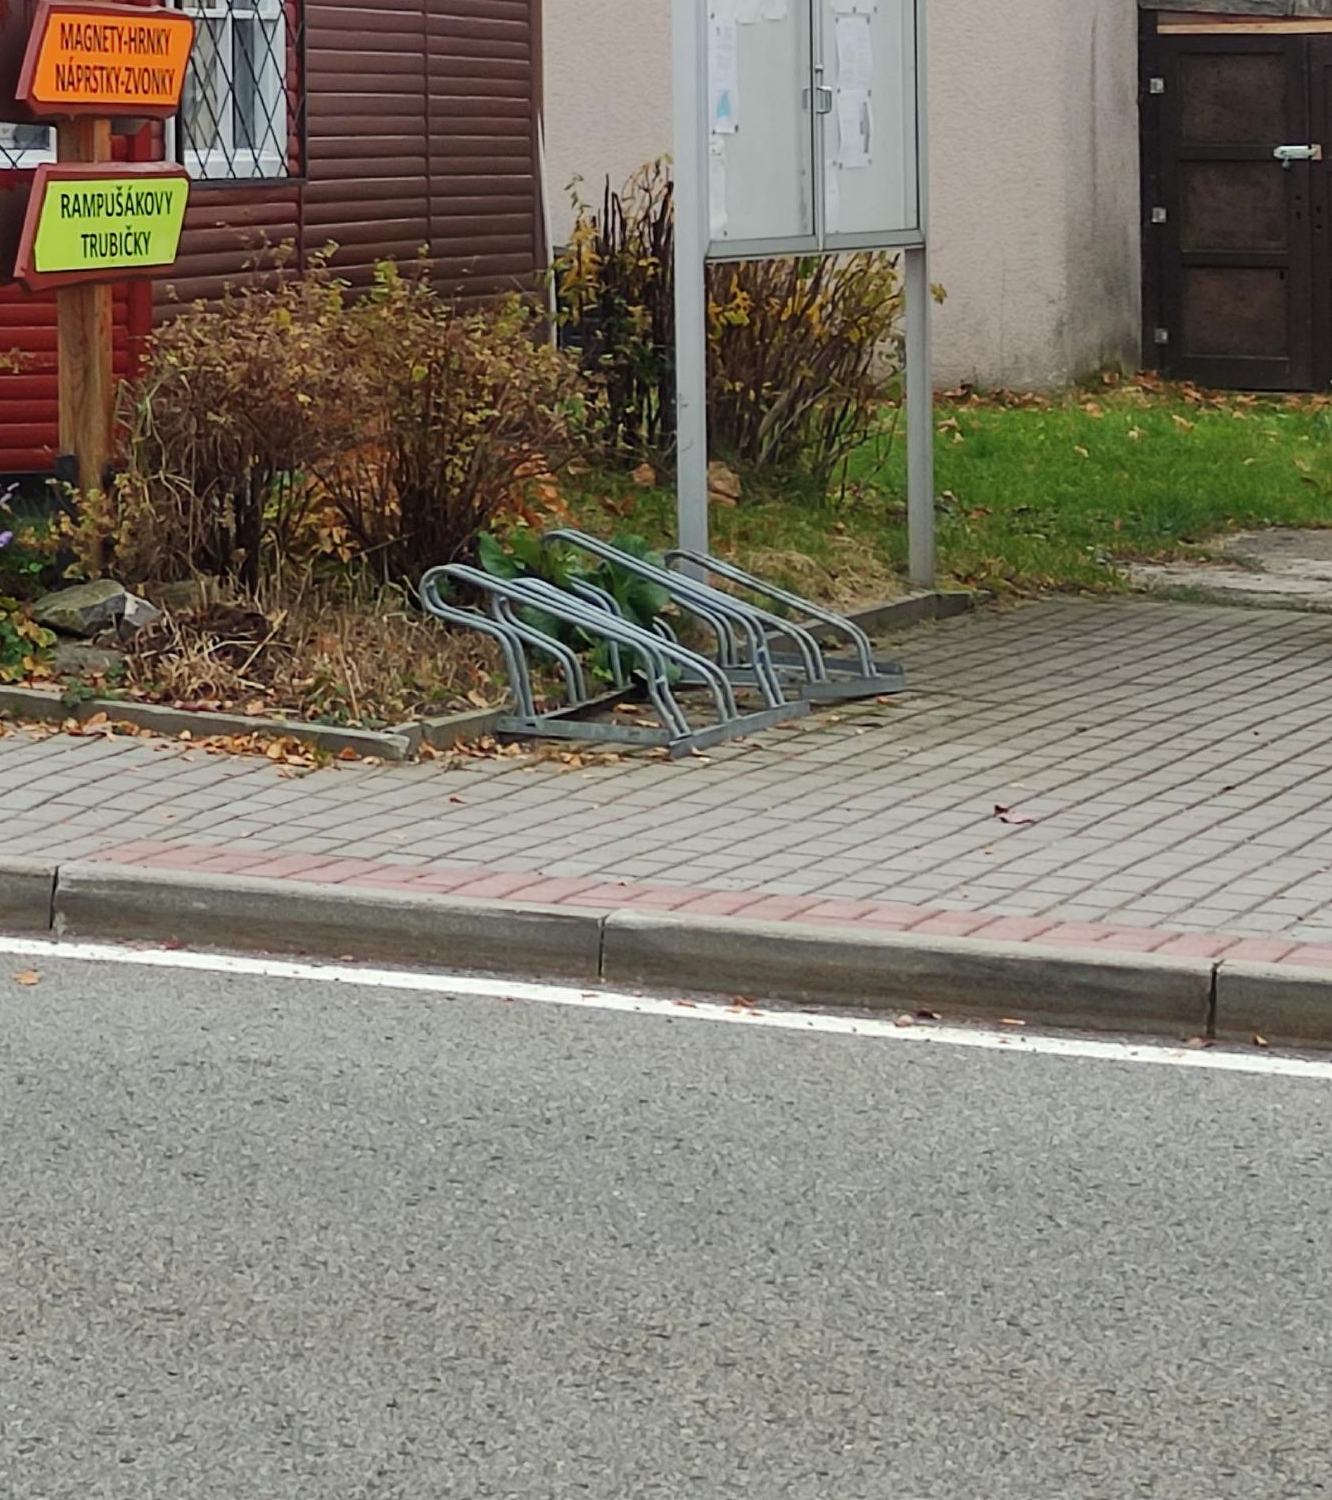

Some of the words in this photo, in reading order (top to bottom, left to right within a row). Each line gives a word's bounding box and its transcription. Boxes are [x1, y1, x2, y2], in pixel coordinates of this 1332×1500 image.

[60, 22, 173, 56] MAGNETY-HRNKY
[55, 56, 176, 96] NÁPRSTKY-ZVONKY
[60, 185, 173, 219] RAMPUŠÁKOVY
[81, 225, 152, 259] TRUBIČKY
